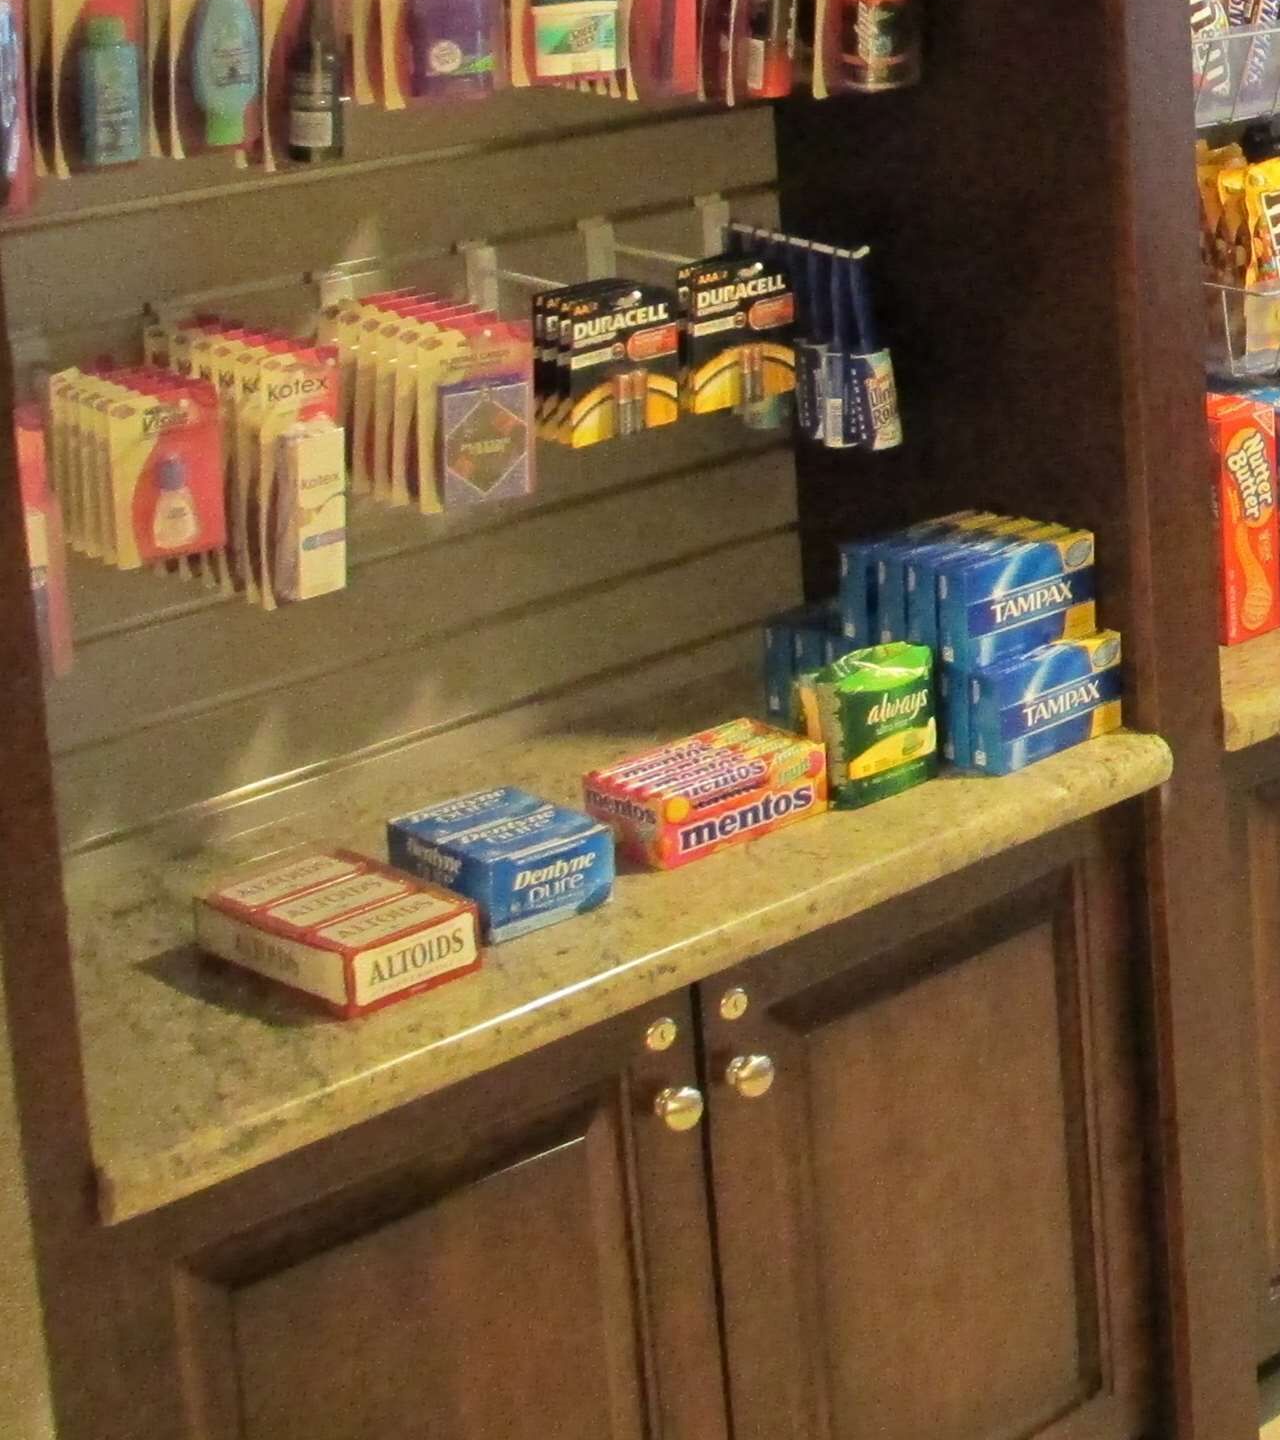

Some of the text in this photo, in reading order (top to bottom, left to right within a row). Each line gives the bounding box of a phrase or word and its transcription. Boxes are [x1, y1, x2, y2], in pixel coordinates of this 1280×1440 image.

[696, 273, 787, 308] DURACELL
[573, 302, 669, 340] DURACELL
[267, 375, 328, 403] kotex
[1227, 449, 1262, 520] Butter
[1241, 431, 1274, 507] Nutter
[990, 581, 1073, 624] TAMPAX
[867, 689, 928, 725] always
[1022, 681, 1101, 728] TAMPAX
[680, 785, 813, 851] mentos
[512, 851, 597, 891] Dentyne
[527, 872, 585, 909] pure
[369, 927, 465, 986] ALTOIDS
